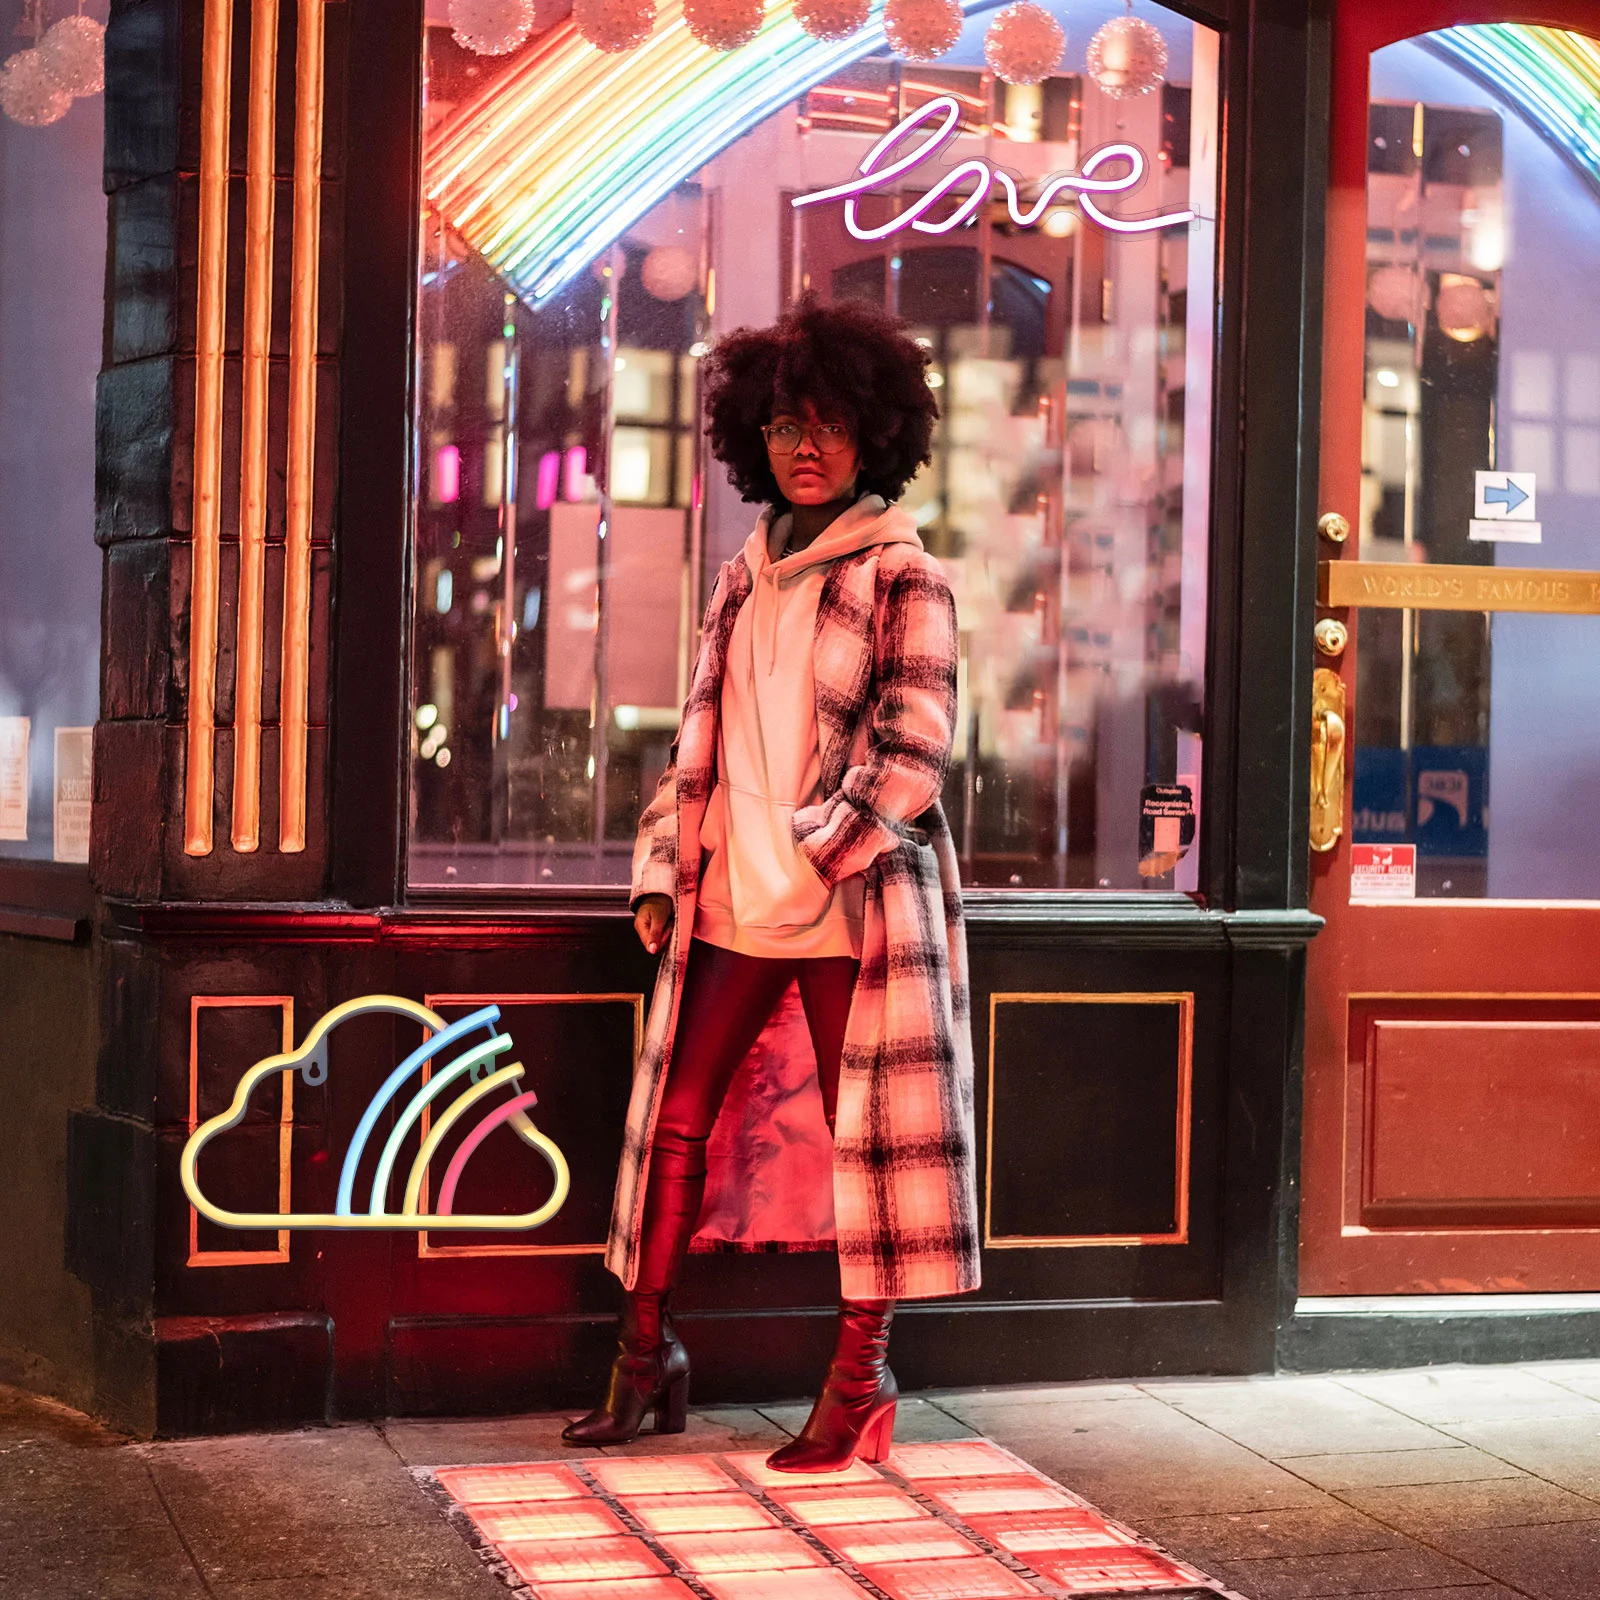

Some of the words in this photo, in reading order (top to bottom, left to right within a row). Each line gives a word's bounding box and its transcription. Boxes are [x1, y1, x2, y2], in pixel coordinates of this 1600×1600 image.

[791, 96, 1195, 242] love
[1363, 576, 1464, 598] WORLD'S
[1476, 579, 1570, 601] FAMOUS
[1145, 799, 1190, 809] Recognizing
[1163, 808, 1185, 816] Sense
[1354, 864, 1385, 874] SECURITY
[1388, 864, 1412, 874] NOTICE
